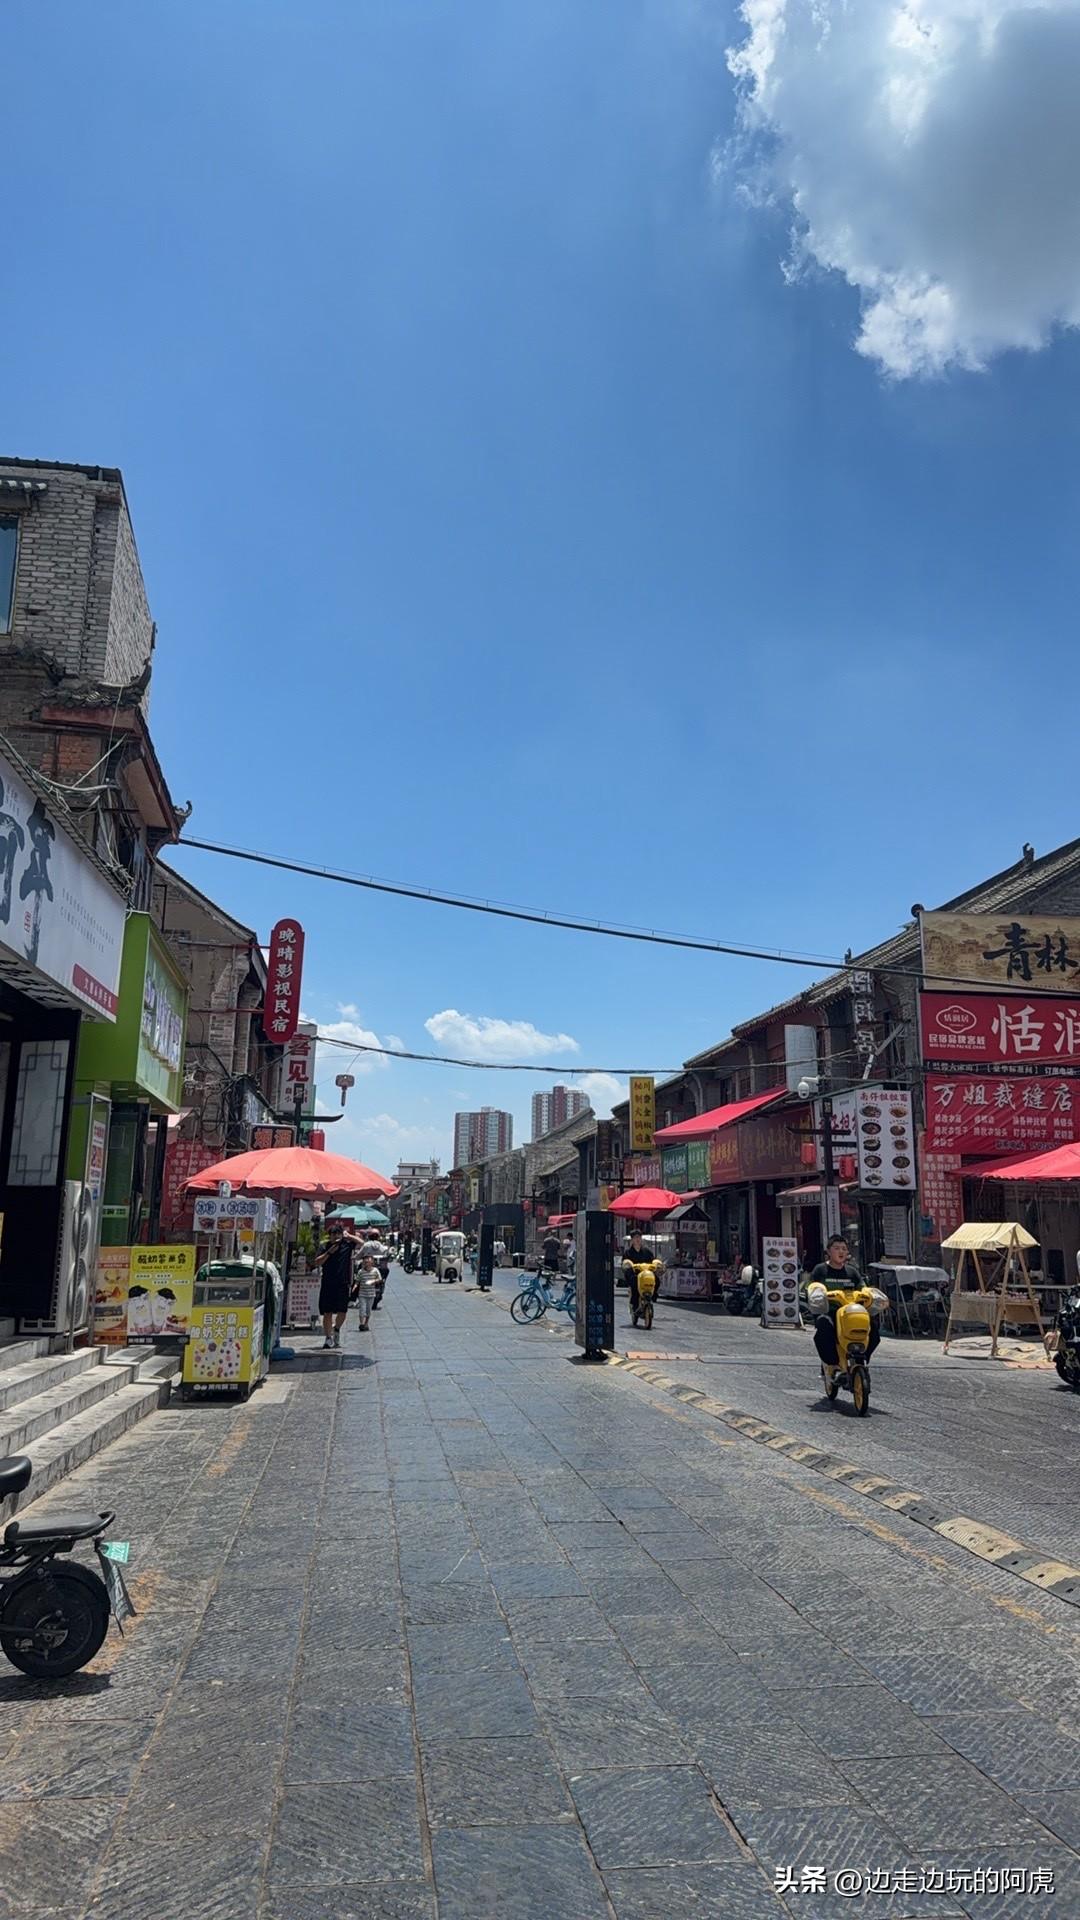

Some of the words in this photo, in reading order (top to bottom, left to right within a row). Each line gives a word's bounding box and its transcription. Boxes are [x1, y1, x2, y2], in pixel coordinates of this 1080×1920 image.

[271, 928, 297, 1032] 晚晴影视民宿
[933, 1081, 1073, 1112] 万姐裁缝店
[203, 1312, 238, 1325] 巨无霸
